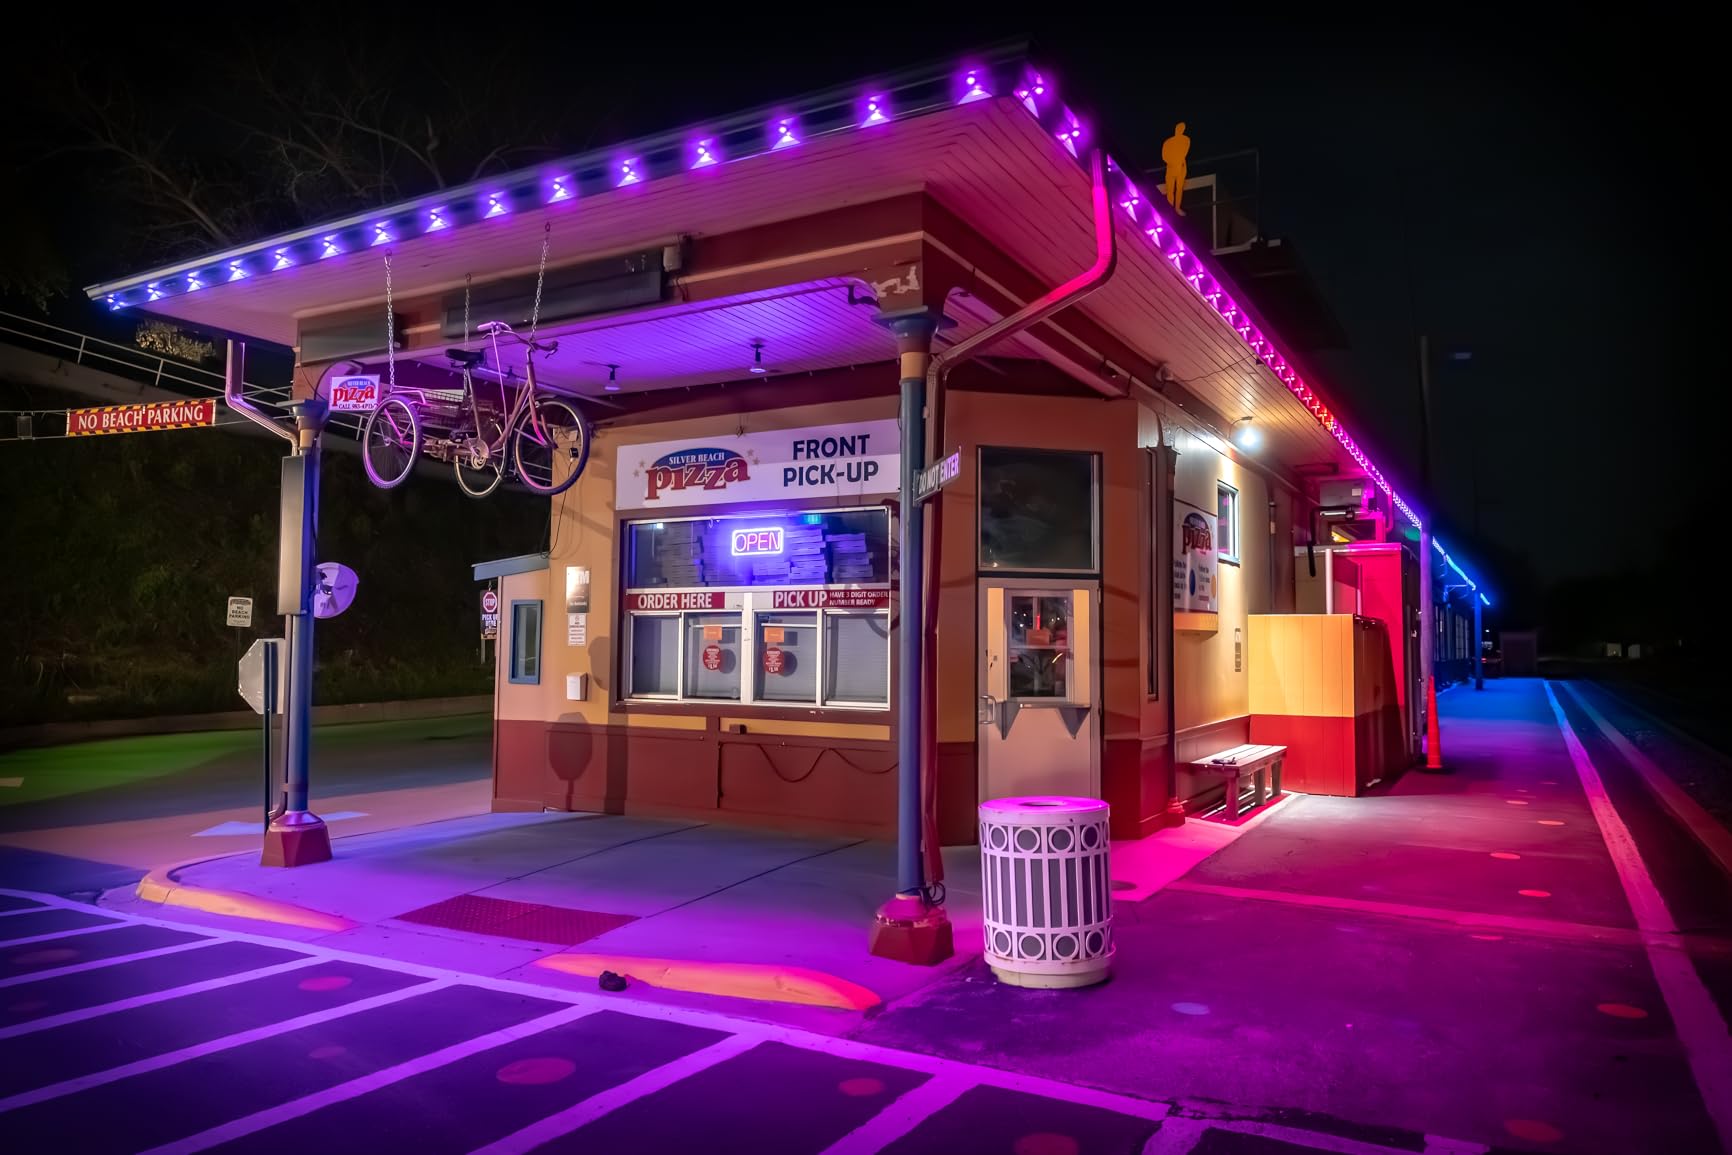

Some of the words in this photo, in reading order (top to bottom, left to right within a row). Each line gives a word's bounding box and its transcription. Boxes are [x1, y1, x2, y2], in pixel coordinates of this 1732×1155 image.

[333, 386, 375, 406] pizza
[78, 415, 97, 430] NO
[102, 410, 143, 427] BEACH
[147, 405, 204, 424] PARKING
[669, 453, 696, 465] SILVER
[698, 451, 725, 463] BEACH
[793, 434, 871, 461] FRONT
[645, 457, 751, 500] pizza
[783, 460, 879, 487] PICK-UP
[926, 464, 940, 490] NOT
[939, 452, 960, 483] ENTER
[734, 532, 781, 552] OPEN
[1181, 524, 1212, 555] pizza
[638, 594, 678, 609] ORDER
[681, 592, 712, 608] HERE
[775, 592, 804, 608] PICK
[808, 591, 828, 608] UP
